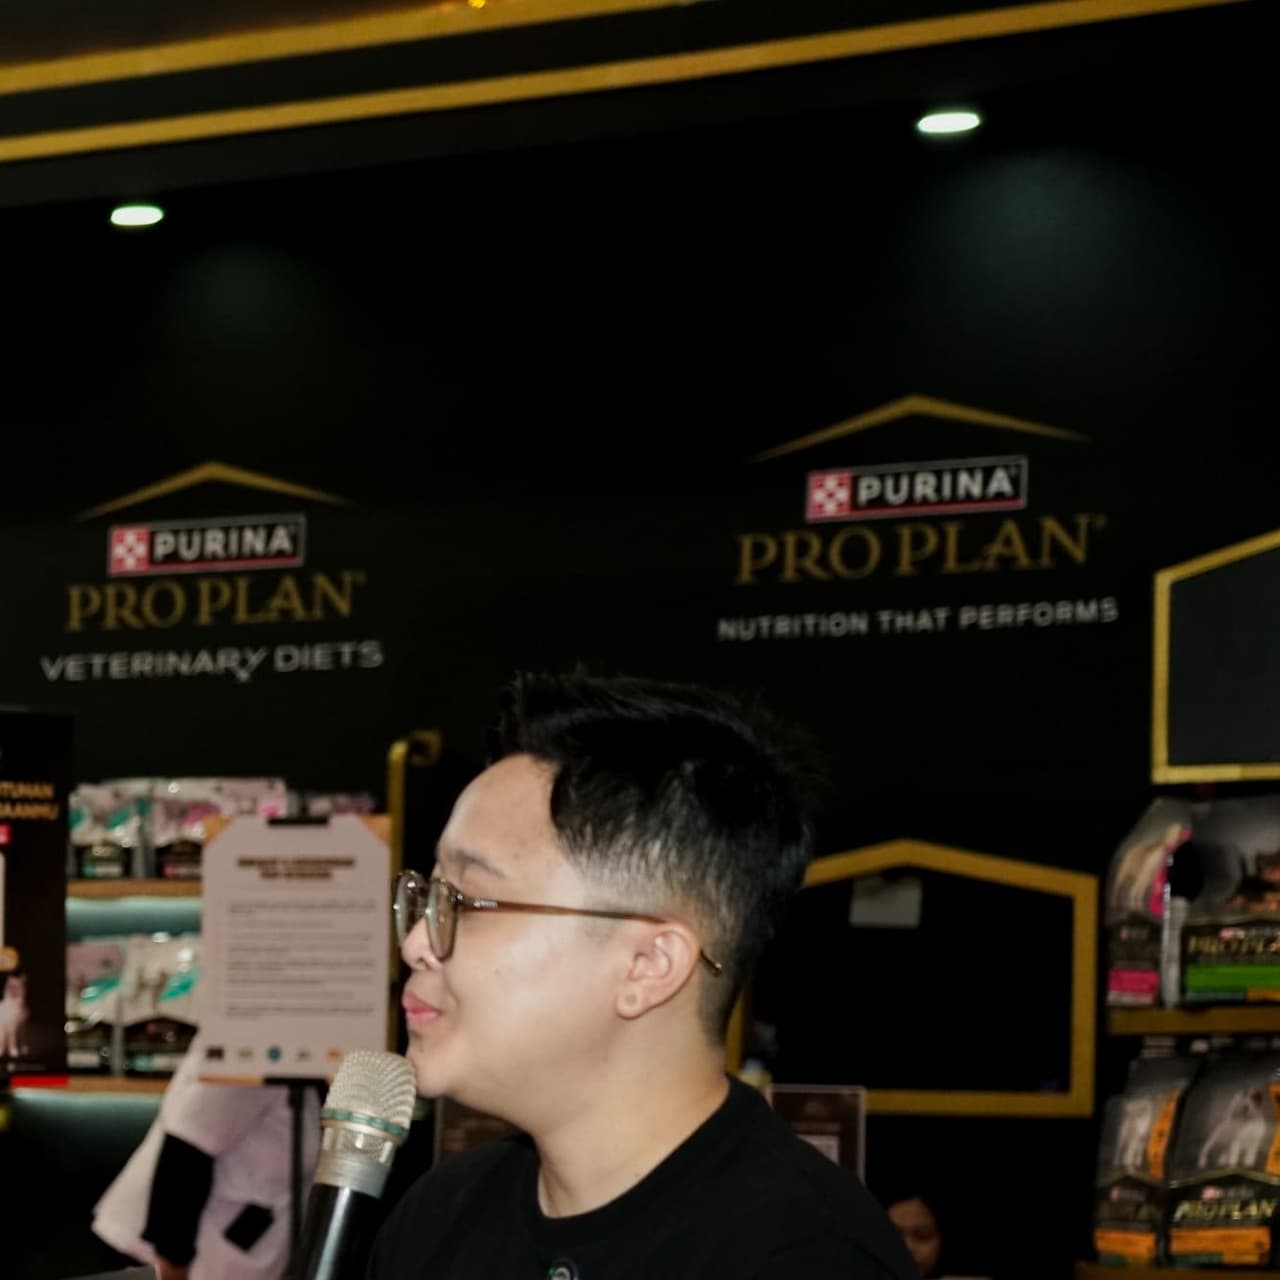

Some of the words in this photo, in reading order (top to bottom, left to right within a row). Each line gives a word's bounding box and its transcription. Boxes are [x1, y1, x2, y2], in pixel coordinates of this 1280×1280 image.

[857, 466, 1015, 506] PURINA
[152, 524, 293, 562] PURINA
[736, 526, 882, 585] PRO
[895, 514, 1093, 576] PLAN
[65, 581, 186, 632] PRO
[195, 572, 354, 626] PLAN
[717, 612, 869, 642] NUTRITION
[878, 606, 951, 633] THAT
[958, 597, 1119, 631] PERFORMS
[40, 647, 268, 682] VETERINARY
[274, 640, 384, 673] DIETS
